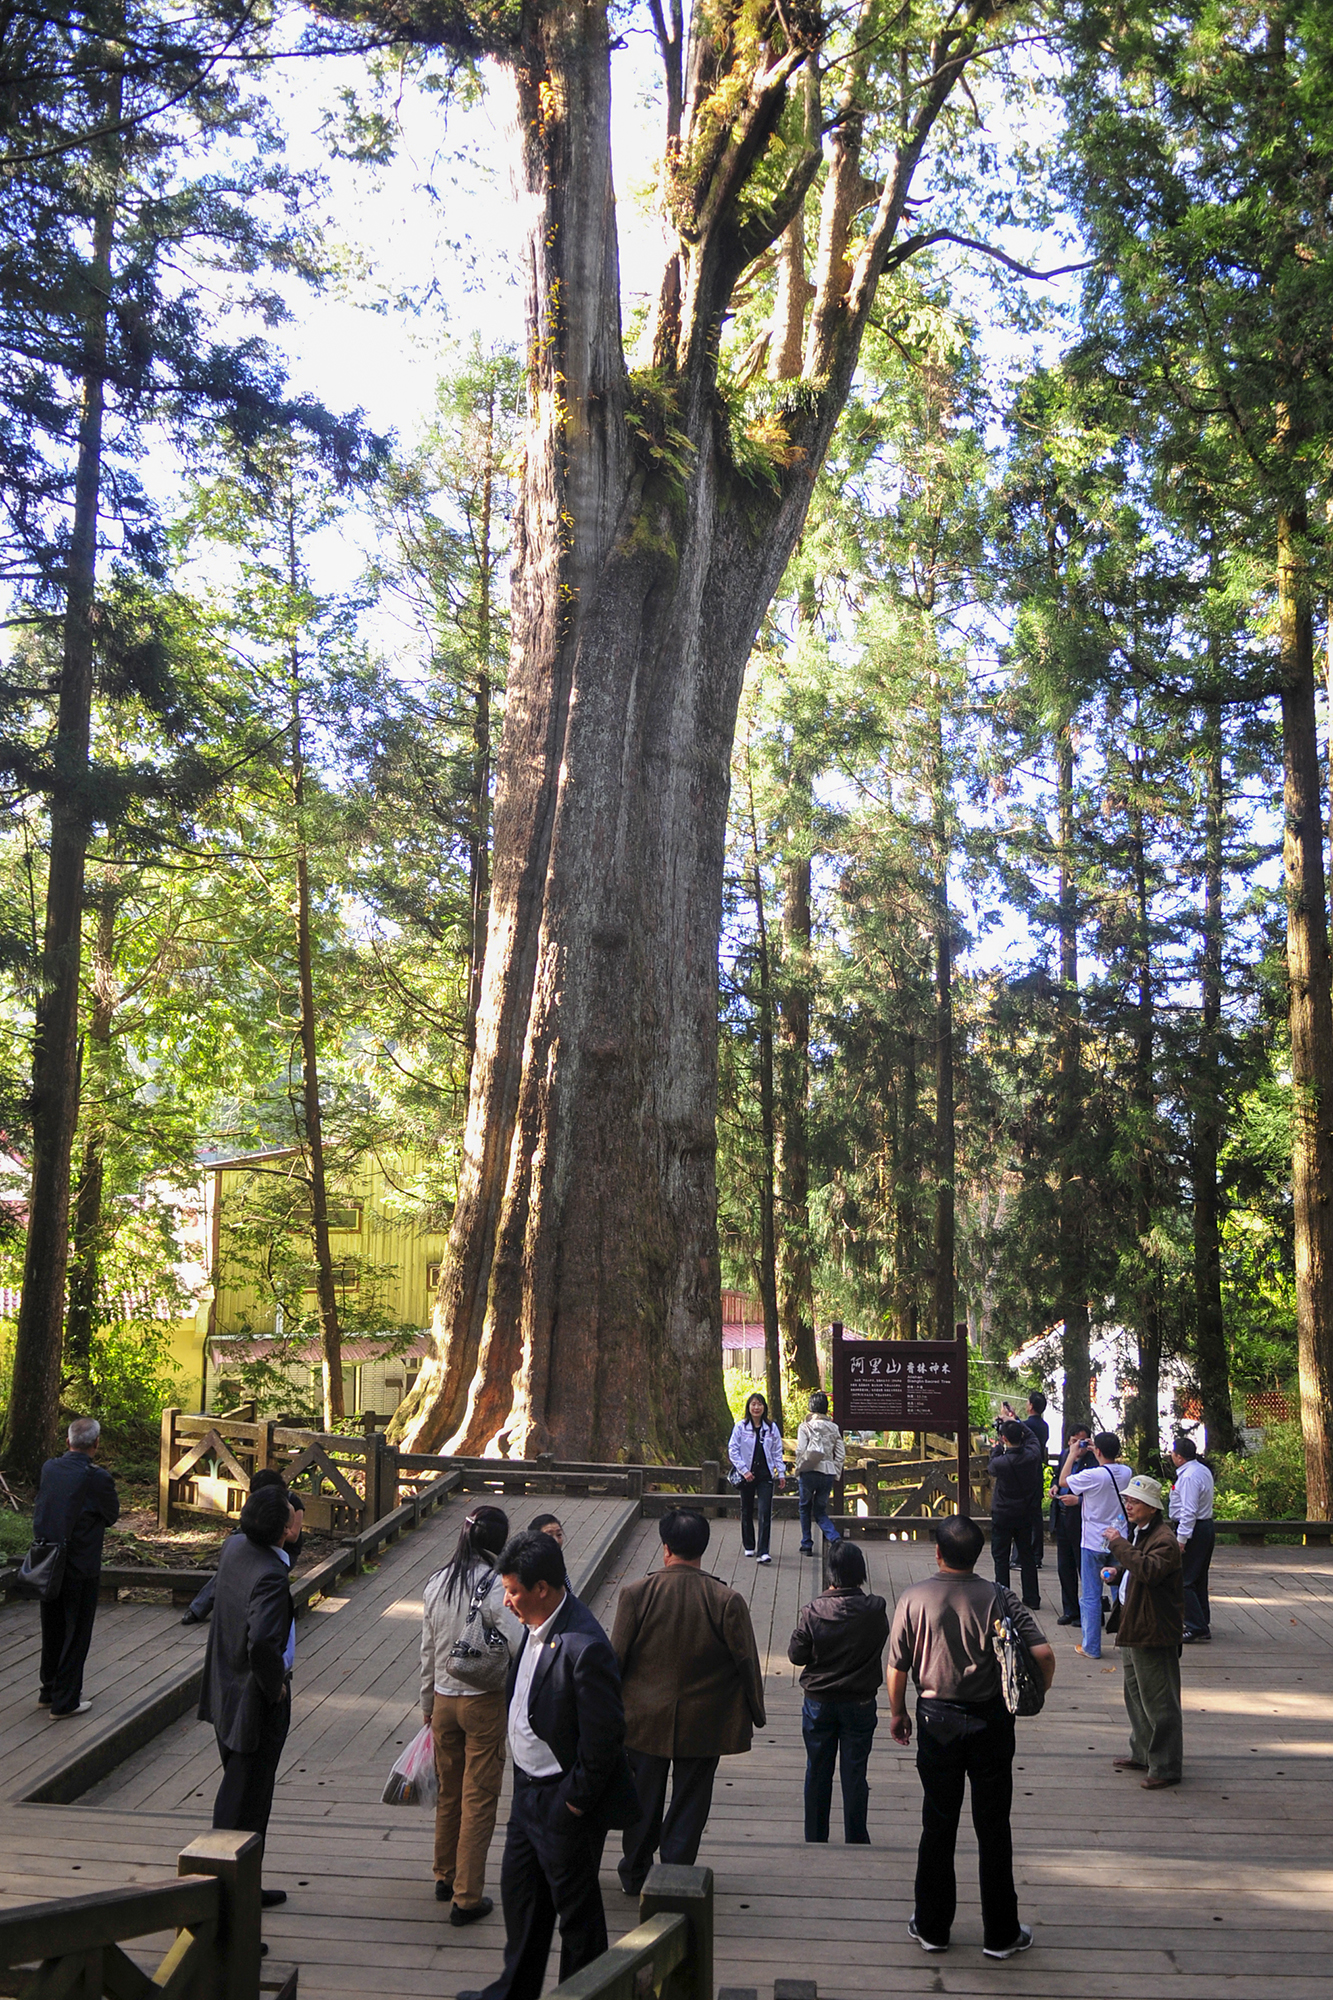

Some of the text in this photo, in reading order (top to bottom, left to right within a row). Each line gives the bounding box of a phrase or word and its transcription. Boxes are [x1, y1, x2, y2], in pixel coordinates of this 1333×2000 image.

[850, 1356, 951, 1374] 阿里山 香林神木
